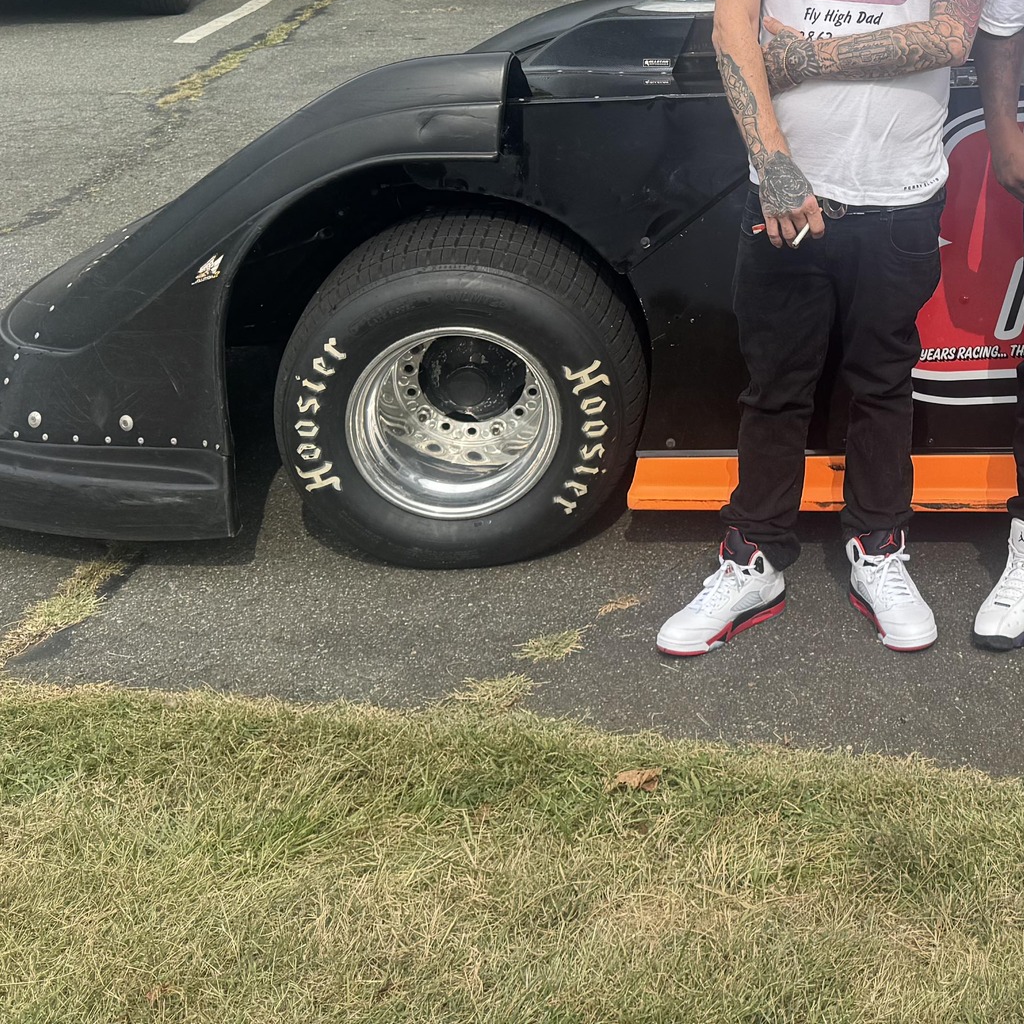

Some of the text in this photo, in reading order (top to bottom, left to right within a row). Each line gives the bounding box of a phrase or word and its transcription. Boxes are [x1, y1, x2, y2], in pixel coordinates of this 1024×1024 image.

[804, 7, 884, 27] Fly High Dad
[919, 346, 956, 361] YEARS
[957, 344, 1008, 359] RACING...
[294, 337, 347, 493] Hoosier
[553, 359, 610, 515] Hoosier
